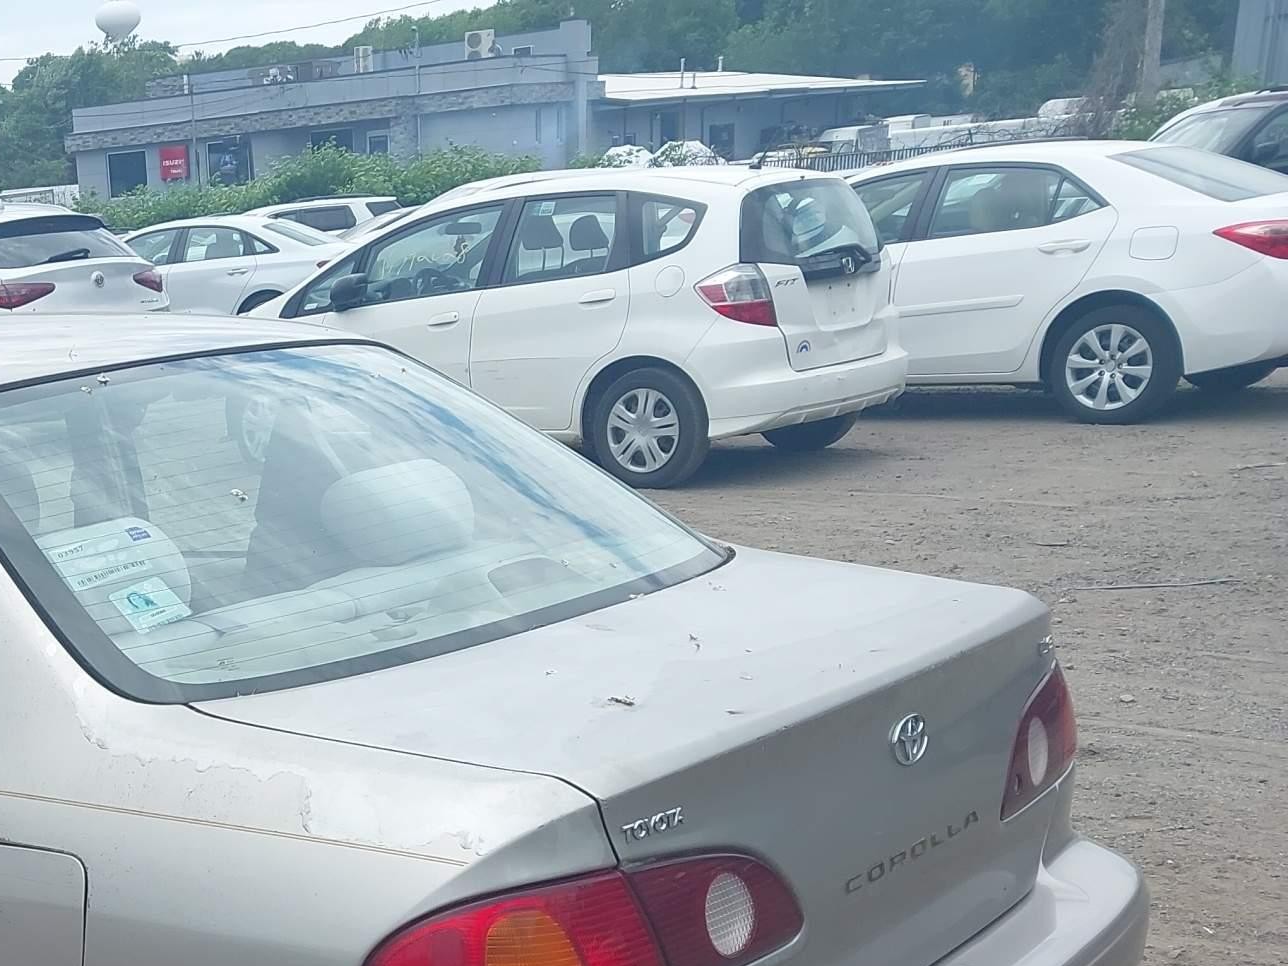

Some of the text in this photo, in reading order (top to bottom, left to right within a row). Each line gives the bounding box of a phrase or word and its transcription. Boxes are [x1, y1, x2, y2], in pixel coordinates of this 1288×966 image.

[774, 277, 799, 288] FIT
[621, 806, 684, 844] TOYOTA
[844, 809, 980, 895] COROLLA
